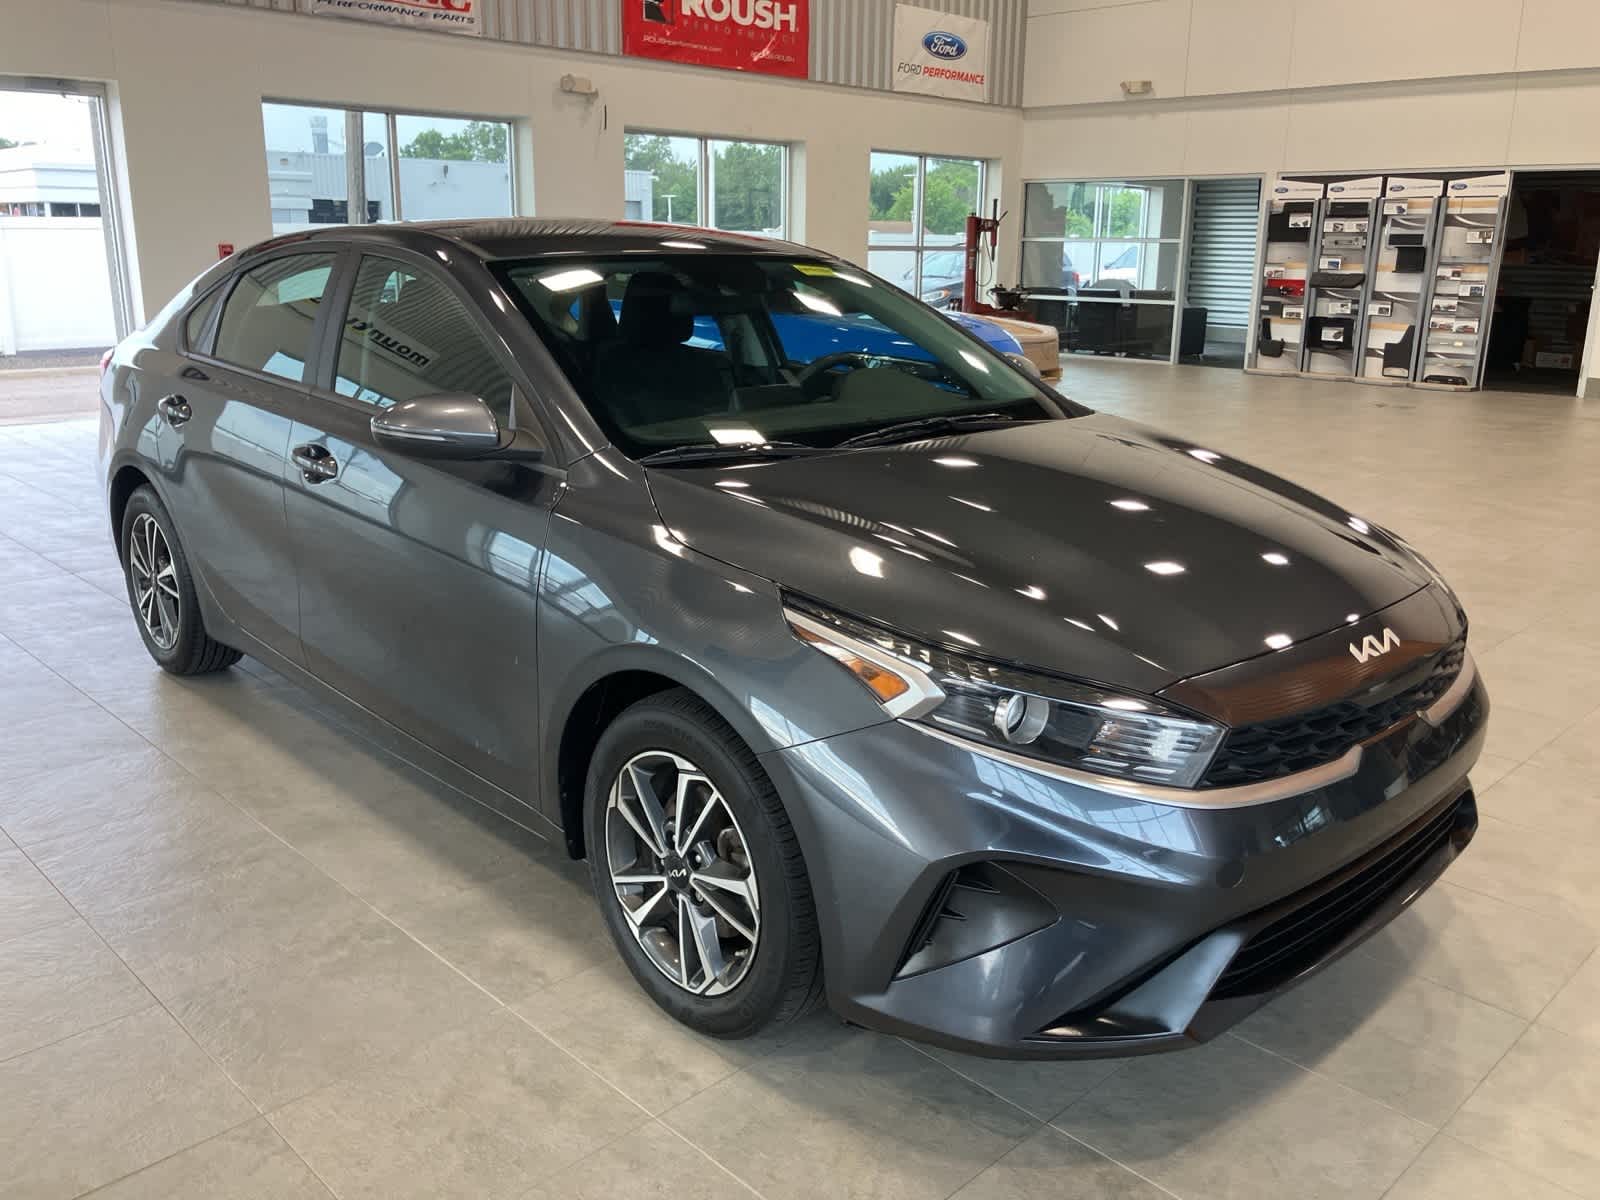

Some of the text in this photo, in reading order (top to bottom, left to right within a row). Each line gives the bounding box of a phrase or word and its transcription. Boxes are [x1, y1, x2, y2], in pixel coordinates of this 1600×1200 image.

[317, 0, 428, 17] ERFORMANCE
[432, 13, 475, 24] PARTS
[681, 0, 797, 32] ROUSH
[930, 35, 959, 56] Ford
[897, 62, 985, 85] FORD PERFORMANCE
